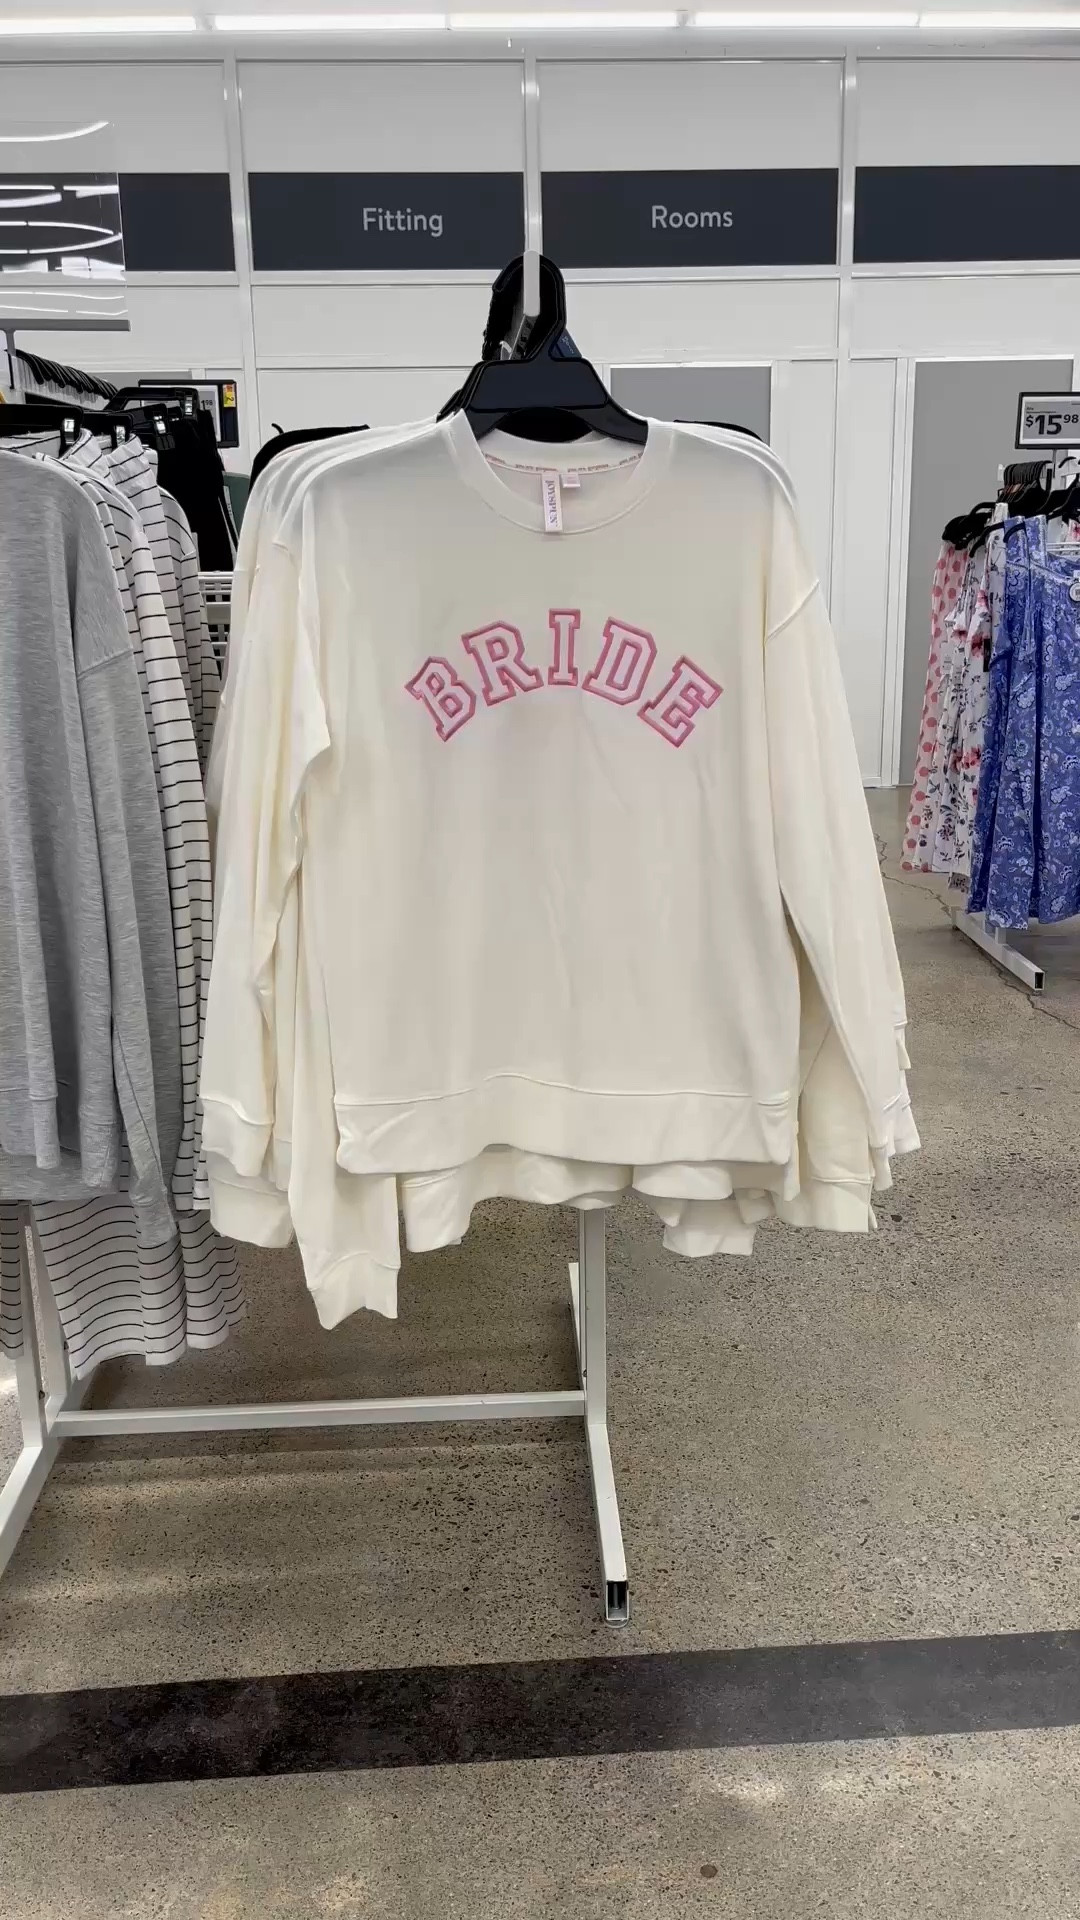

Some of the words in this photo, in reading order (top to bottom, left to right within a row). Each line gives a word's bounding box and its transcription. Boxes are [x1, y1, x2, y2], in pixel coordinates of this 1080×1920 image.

[362, 207, 443, 237] Fitting
[651, 205, 733, 229] Rooms
[404, 607, 724, 748] BRIDE
